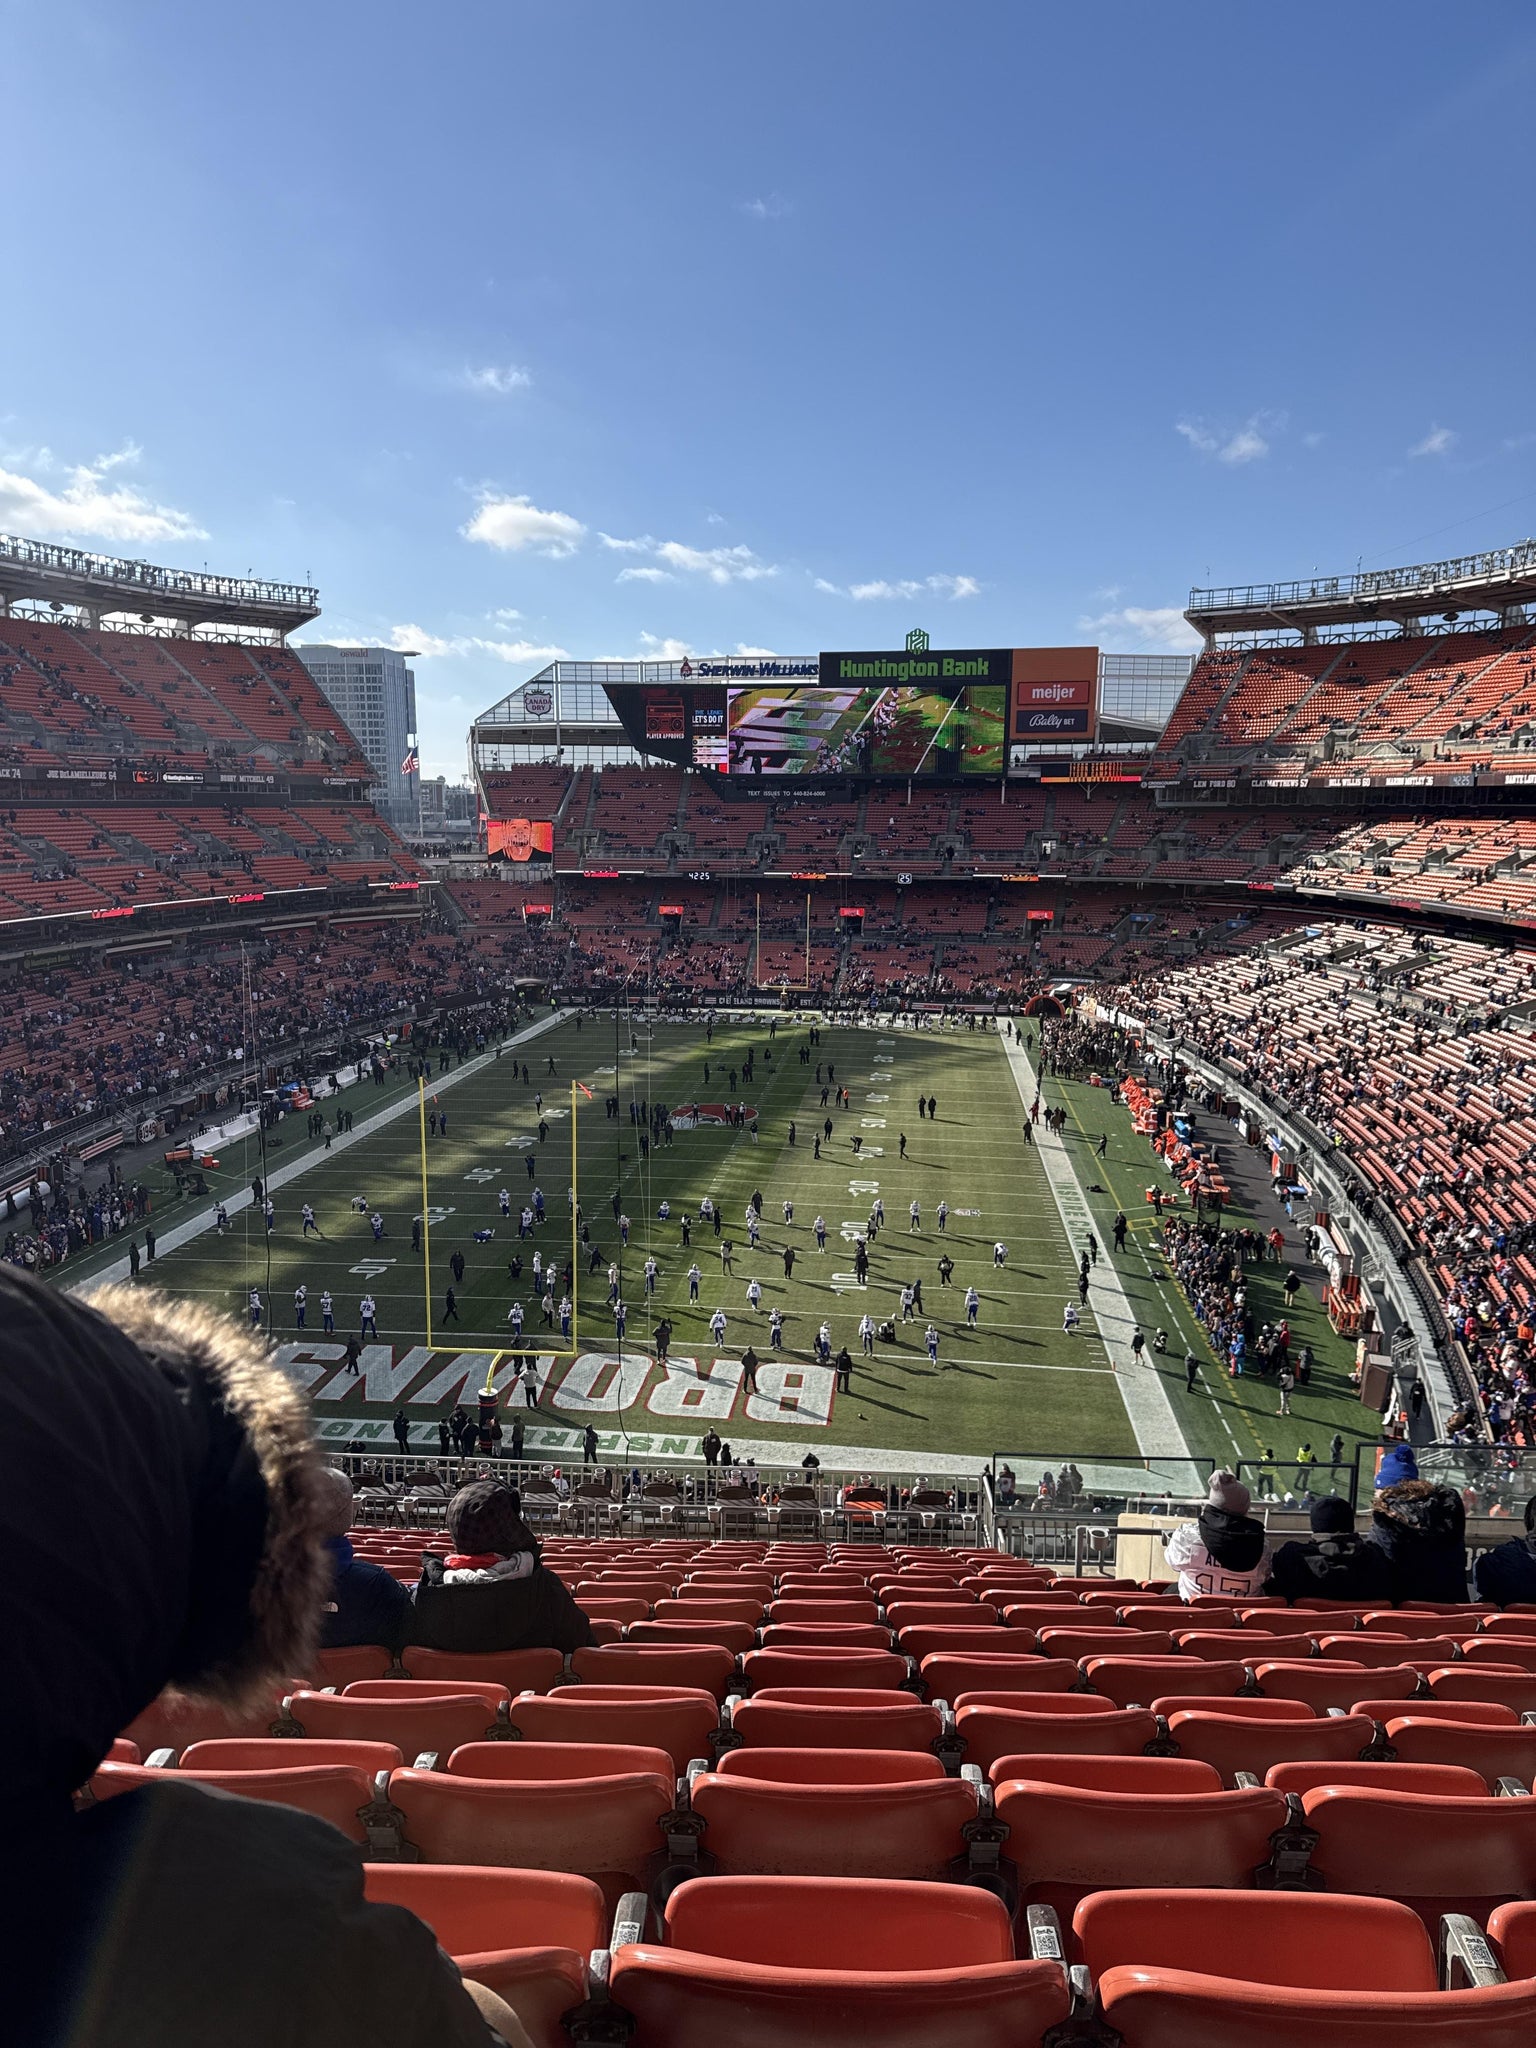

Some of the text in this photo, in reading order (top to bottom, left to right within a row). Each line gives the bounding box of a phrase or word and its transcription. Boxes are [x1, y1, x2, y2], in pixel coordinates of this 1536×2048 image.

[340, 648, 369, 658] oswald
[698, 662, 818, 677] SHERWIN-WILLIAMS
[839, 658, 989, 681] Huntington Bank
[1031, 685, 1075, 702] meijer
[692, 715, 724, 723] LET'S DO IT
[1029, 713, 1075, 729] Bally BET
[47, 770, 59, 778] JOE
[266, 775, 275, 783] 49
[1251, 779, 1267, 787] CLAY
[1267, 779, 1299, 787] MATTHEWS
[718, 996, 781, 1005] CLEELAND BROWNS
[268, 1342, 838, 1427] BROWNS
